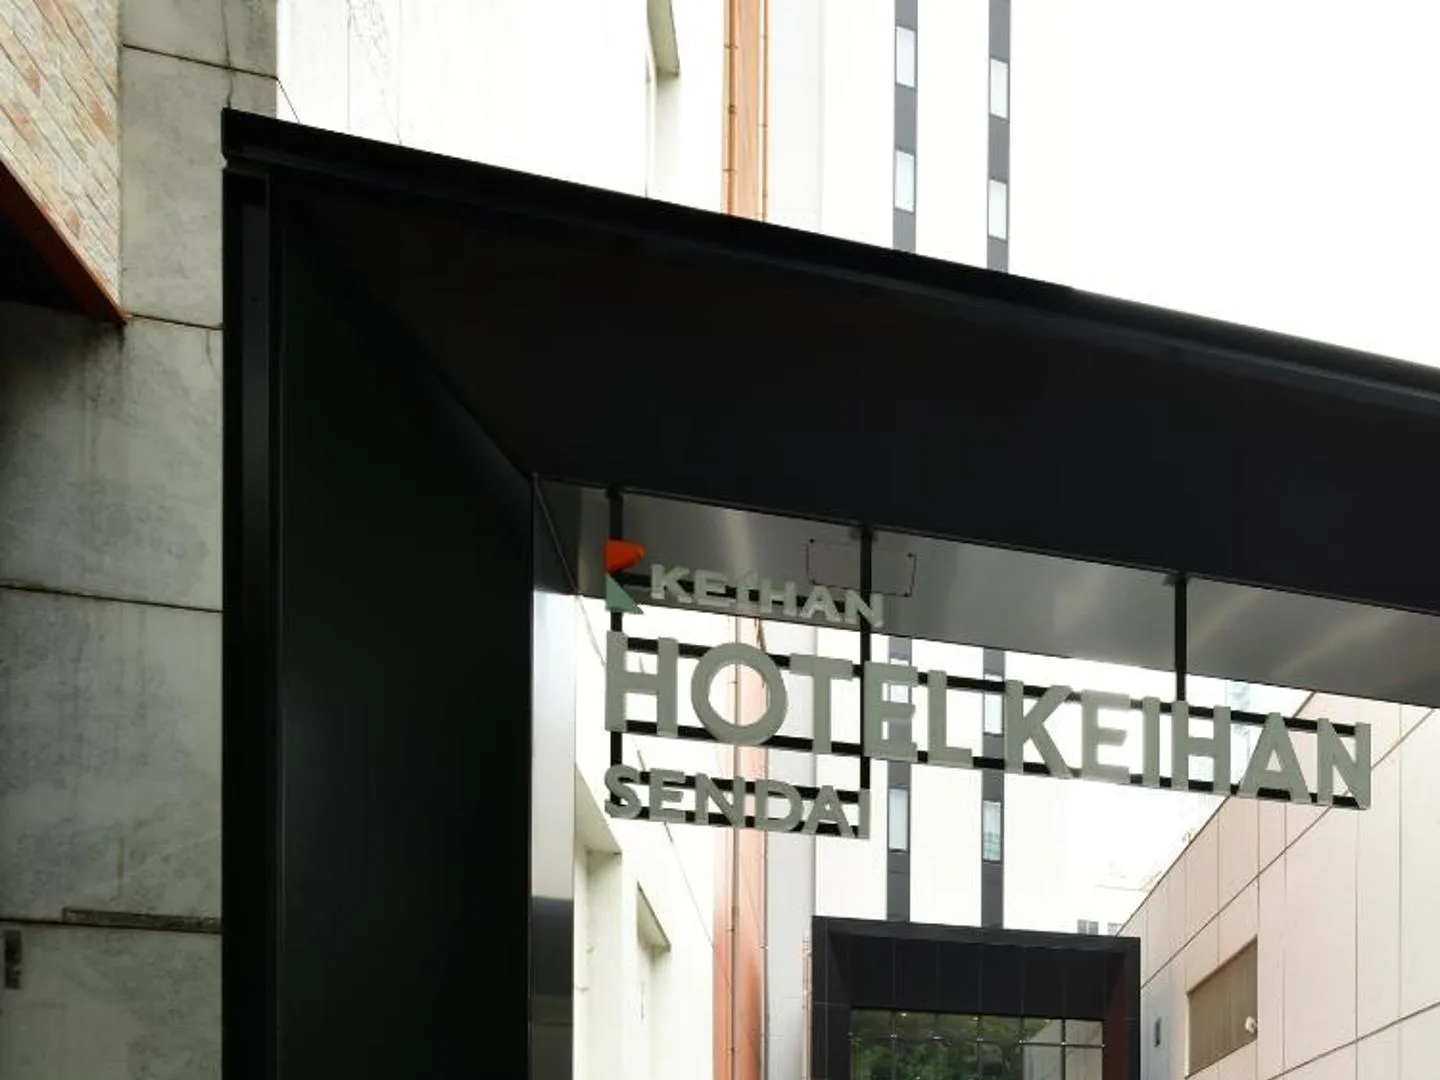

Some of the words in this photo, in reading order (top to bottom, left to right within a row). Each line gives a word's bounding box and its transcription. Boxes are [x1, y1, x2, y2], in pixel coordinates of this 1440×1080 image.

[649, 563, 885, 628] KEIHAN
[605, 630, 974, 768] HOTEL
[1004, 679, 1372, 810] KEIHAN
[603, 765, 871, 839] SENDAI
